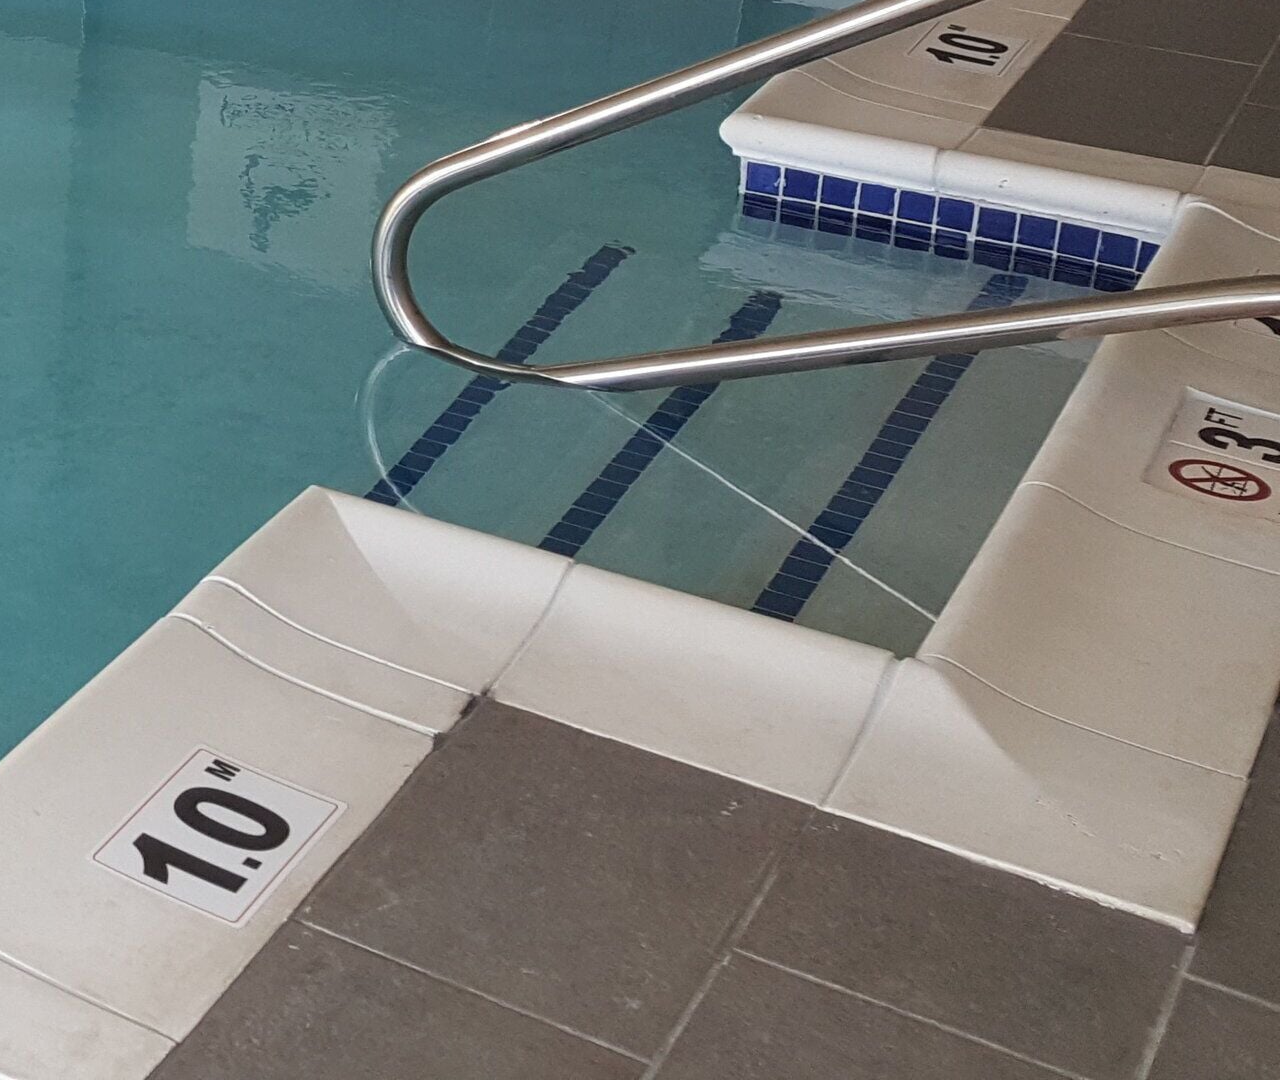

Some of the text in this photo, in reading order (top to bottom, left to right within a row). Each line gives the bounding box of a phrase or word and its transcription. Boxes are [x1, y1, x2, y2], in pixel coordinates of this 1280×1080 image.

[926, 32, 1009, 66] 1.0
[1198, 407, 1280, 464] 3 FT
[132, 758, 290, 893] 1.0 M
